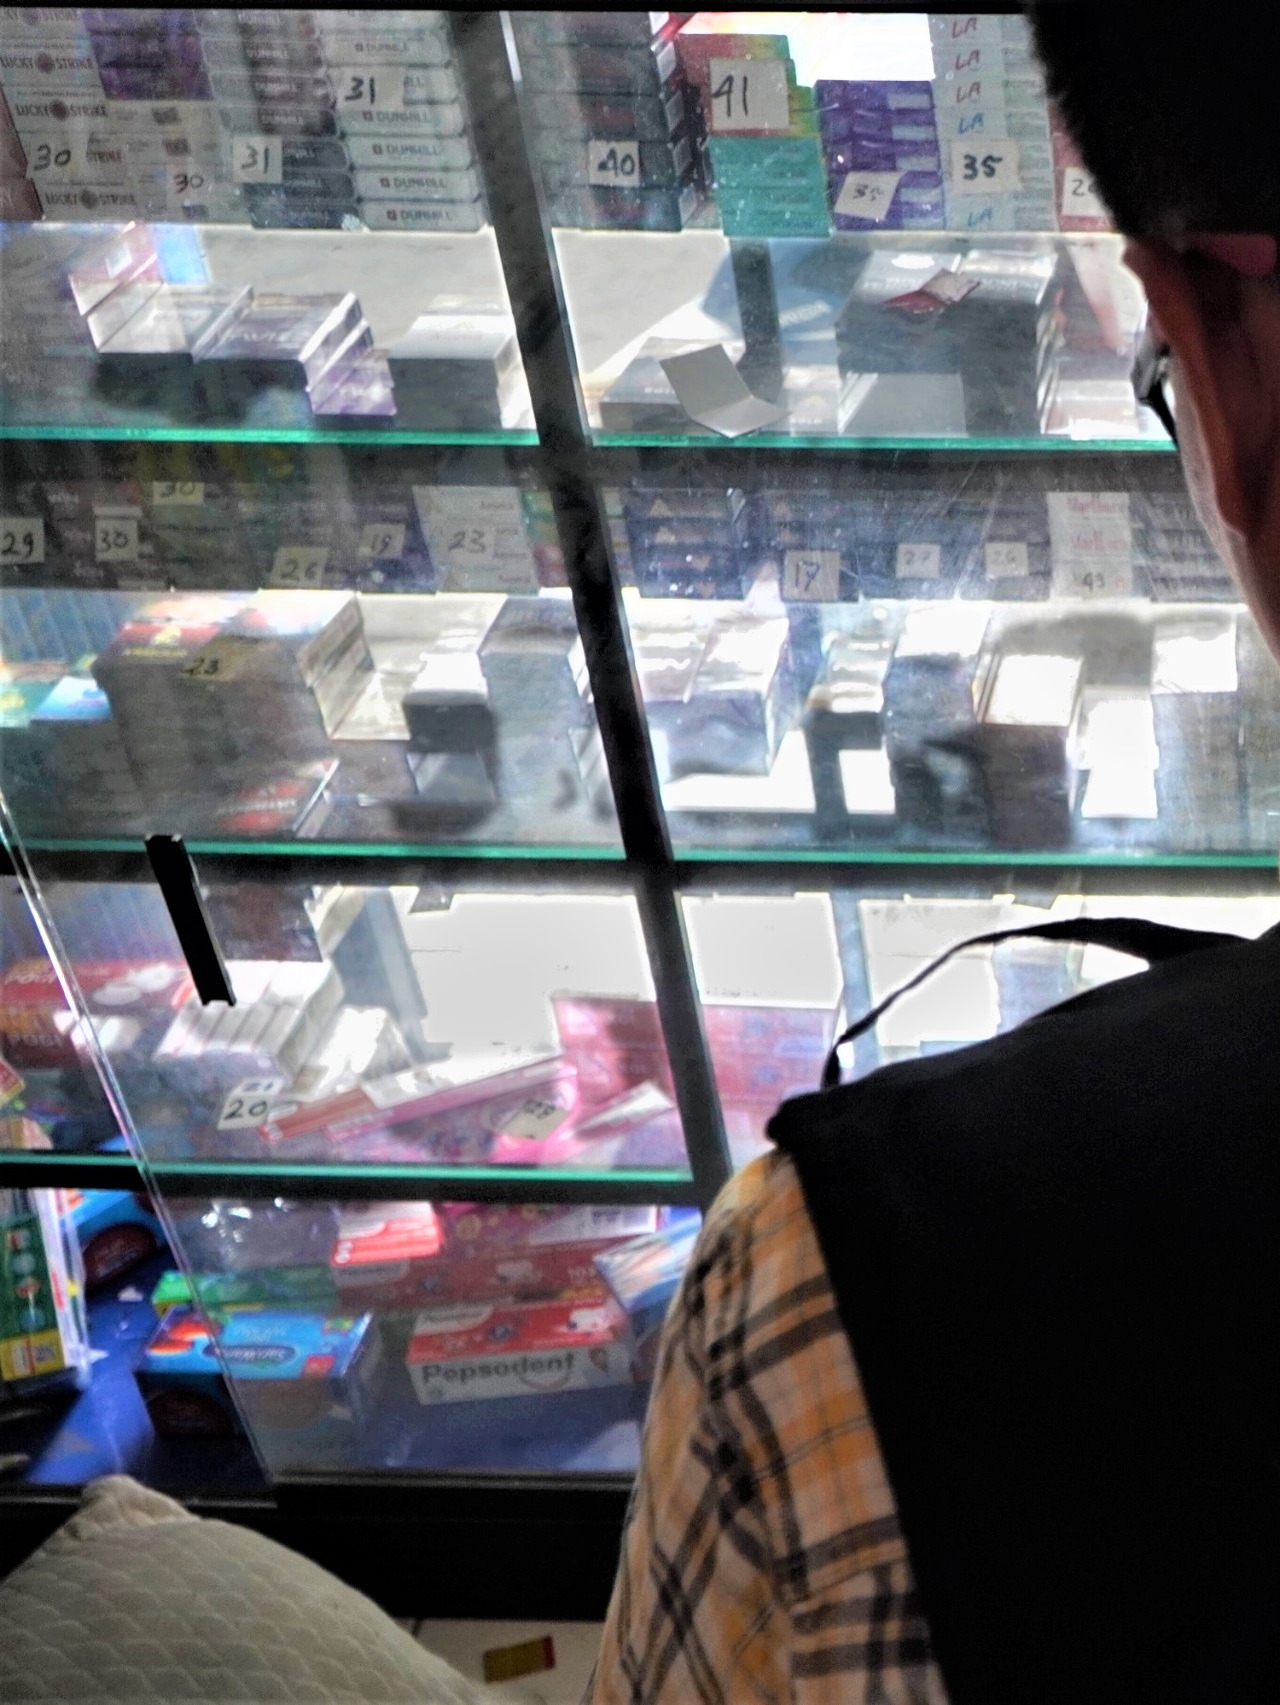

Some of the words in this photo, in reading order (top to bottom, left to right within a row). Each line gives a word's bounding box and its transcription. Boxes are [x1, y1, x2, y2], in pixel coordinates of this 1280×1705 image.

[951, 17, 978, 38] LA
[954, 50, 980, 70] LA
[344, 76, 375, 105] 31
[712, 74, 748, 118] 41
[956, 81, 981, 103] LA
[958, 112, 984, 134] LA
[33, 143, 71, 171] 30
[241, 144, 269, 174] 31
[963, 154, 1003, 180] 35
[174, 172, 204, 194] 30
[967, 207, 992, 226] LA
[2, 531, 34, 560] 29
[100, 529, 129, 552] 30
[449, 528, 487, 553] 23
[225, 1098, 268, 1120] 20
[421, 1350, 575, 1384] Pepsodent
